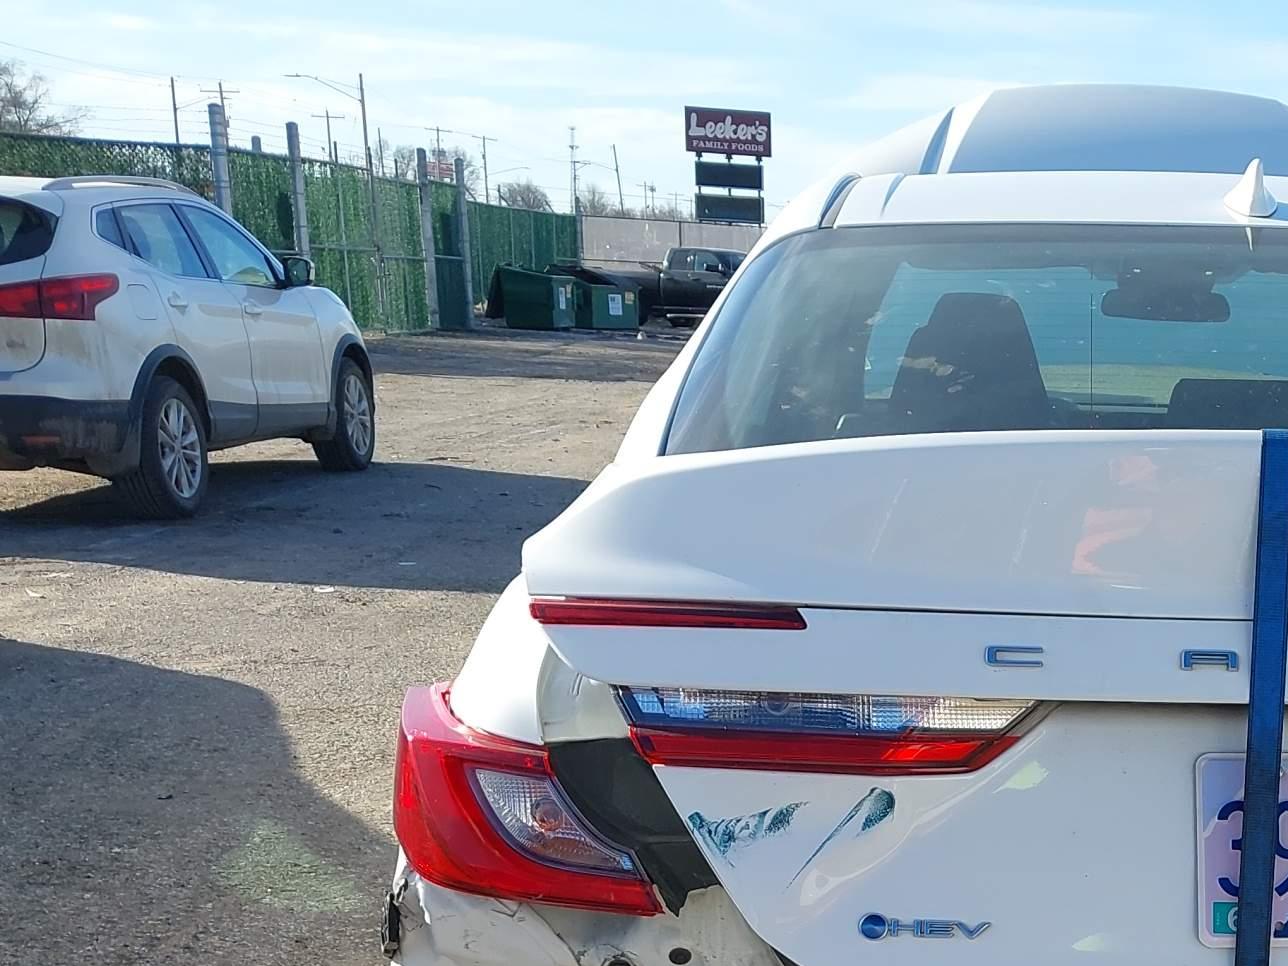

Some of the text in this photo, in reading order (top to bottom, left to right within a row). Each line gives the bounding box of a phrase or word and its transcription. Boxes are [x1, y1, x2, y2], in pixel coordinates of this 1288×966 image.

[688, 112, 768, 142] Leeker's
[692, 139, 764, 152] FAMILY FOODS
[888, 917, 992, 940] HEV
